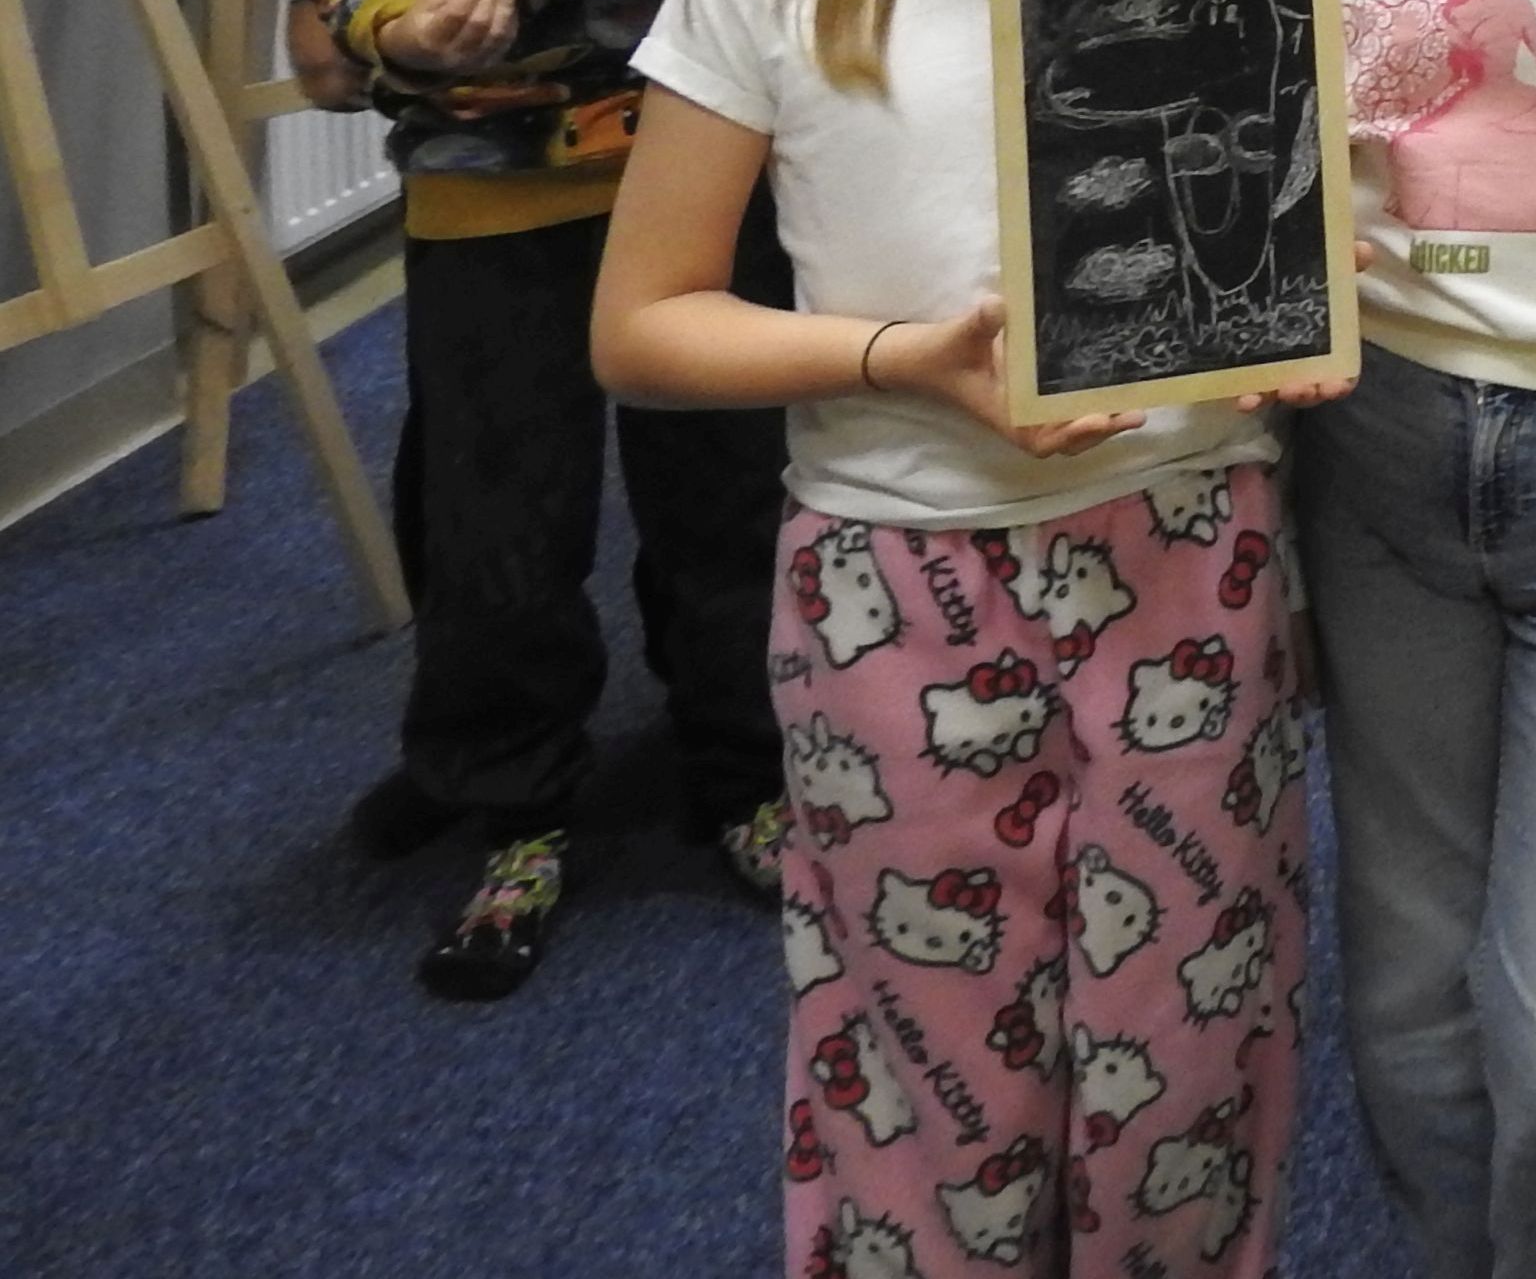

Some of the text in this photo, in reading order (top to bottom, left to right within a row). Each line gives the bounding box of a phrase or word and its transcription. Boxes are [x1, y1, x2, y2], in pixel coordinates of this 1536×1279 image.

[1410, 239, 1489, 274] WICKED
[920, 555, 978, 647] Kitty
[1117, 780, 1224, 906] Hello Kitty
[873, 980, 990, 1146] Hello Kitty
